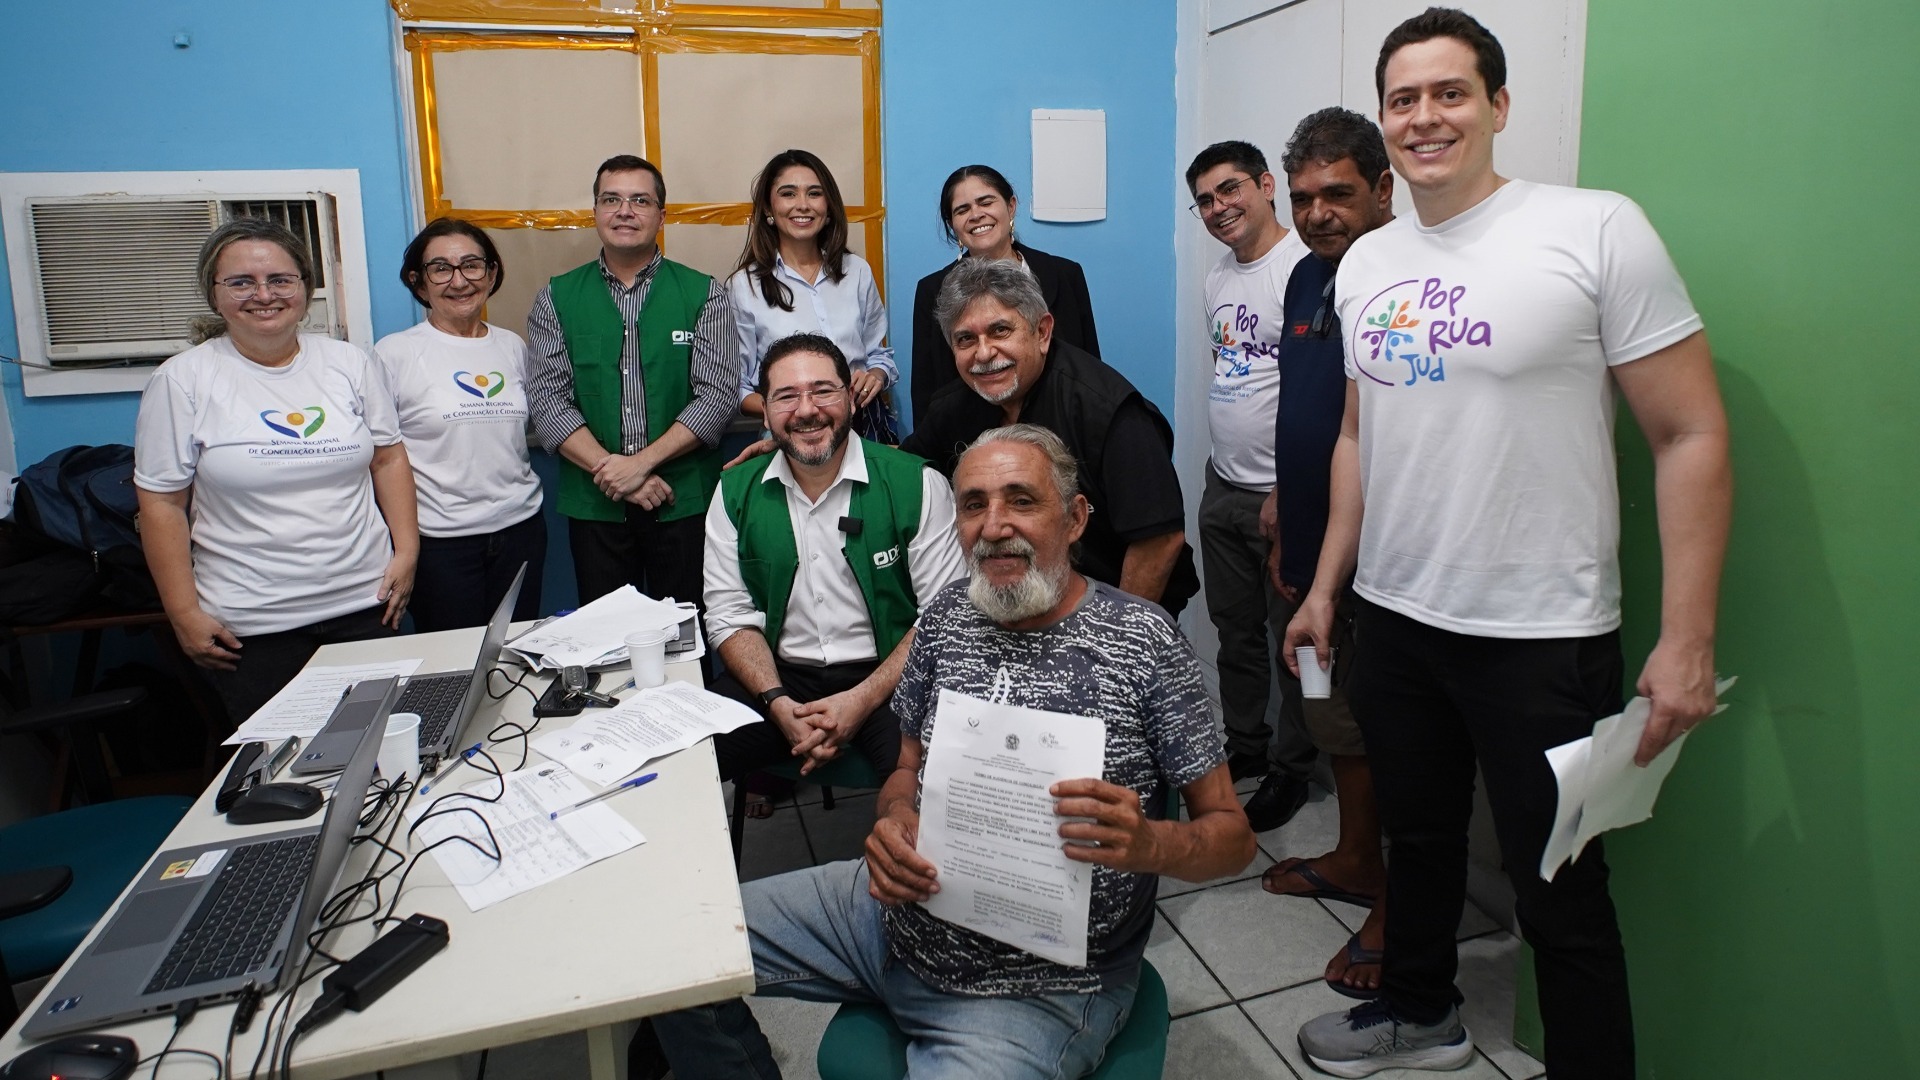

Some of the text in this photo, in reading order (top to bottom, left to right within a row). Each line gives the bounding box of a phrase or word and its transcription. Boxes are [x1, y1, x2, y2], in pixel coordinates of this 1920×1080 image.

[1419, 277, 1466, 316] Pop
[1236, 304, 1258, 340] Pop
[1398, 354, 1445, 386] Jud
[453, 409, 494, 418] CONCILIAÇÃO
[303, 437, 340, 446] REGIONAL
[323, 444, 360, 454] CIDADANIA
